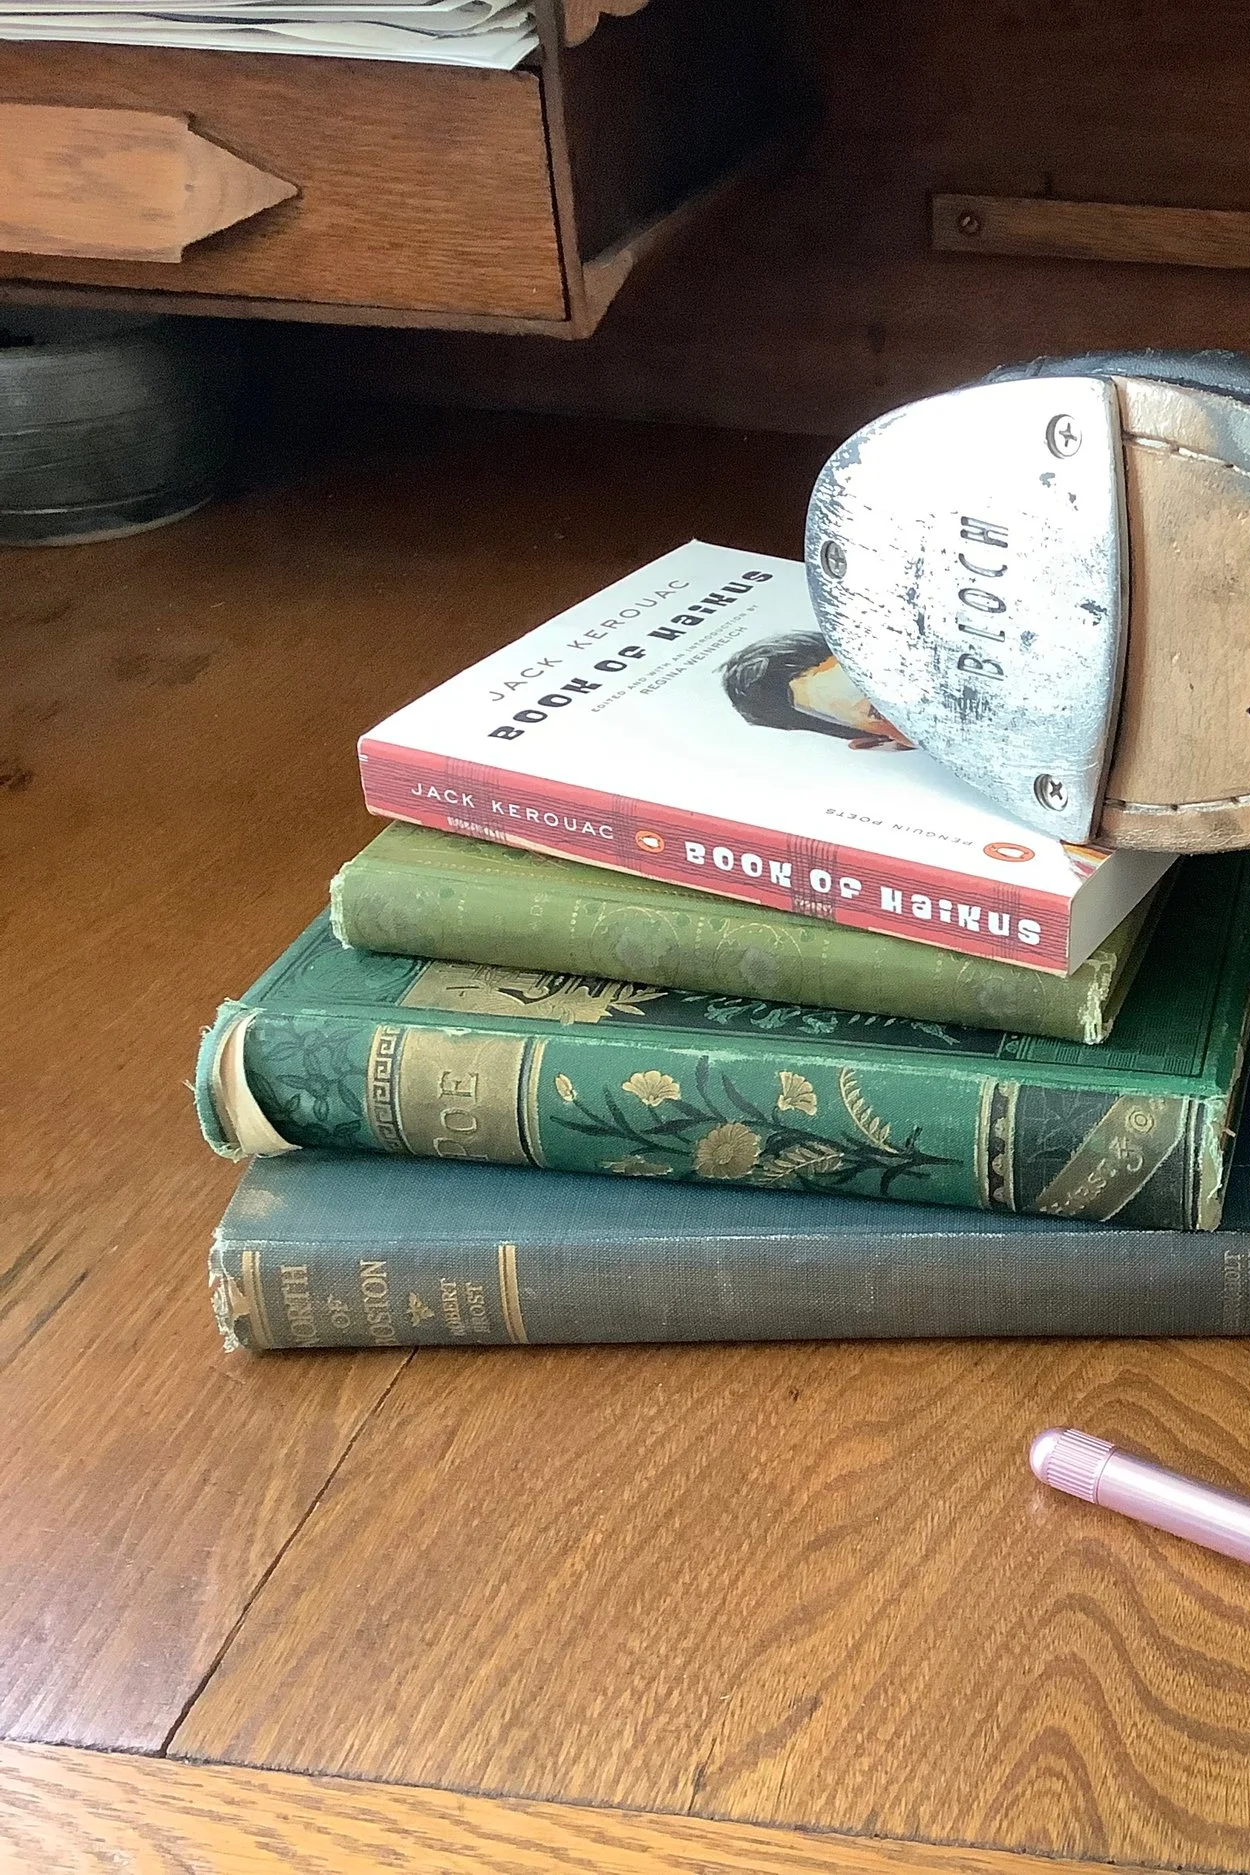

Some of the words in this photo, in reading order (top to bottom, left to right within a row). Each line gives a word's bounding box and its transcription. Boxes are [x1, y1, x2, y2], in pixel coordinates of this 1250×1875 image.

[957, 515, 1008, 682] BLOCH
[488, 657, 563, 703] JACK
[566, 578, 690, 651] KEROUAC
[591, 690, 627, 713] EDITED
[627, 676, 648, 691] AND
[648, 662, 671, 677] WITH
[671, 652, 686, 663] AN
[685, 612, 748, 654] INTRODUCTION
[639, 667, 688, 695] REGINA
[683, 625, 750, 667] WEINREICH
[487, 677, 602, 741] BOOK
[593, 645, 646, 673] OF
[411, 782, 476, 809] JACK
[491, 799, 614, 840] KEROUAC
[825, 808, 883, 826] POETS
[892, 823, 974, 846] PENGUIN
[684, 840, 794, 889] BOOK
[809, 868, 863, 900] OF
[433, 1068, 489, 1160] POE
[327, 1293, 352, 1330] OF
